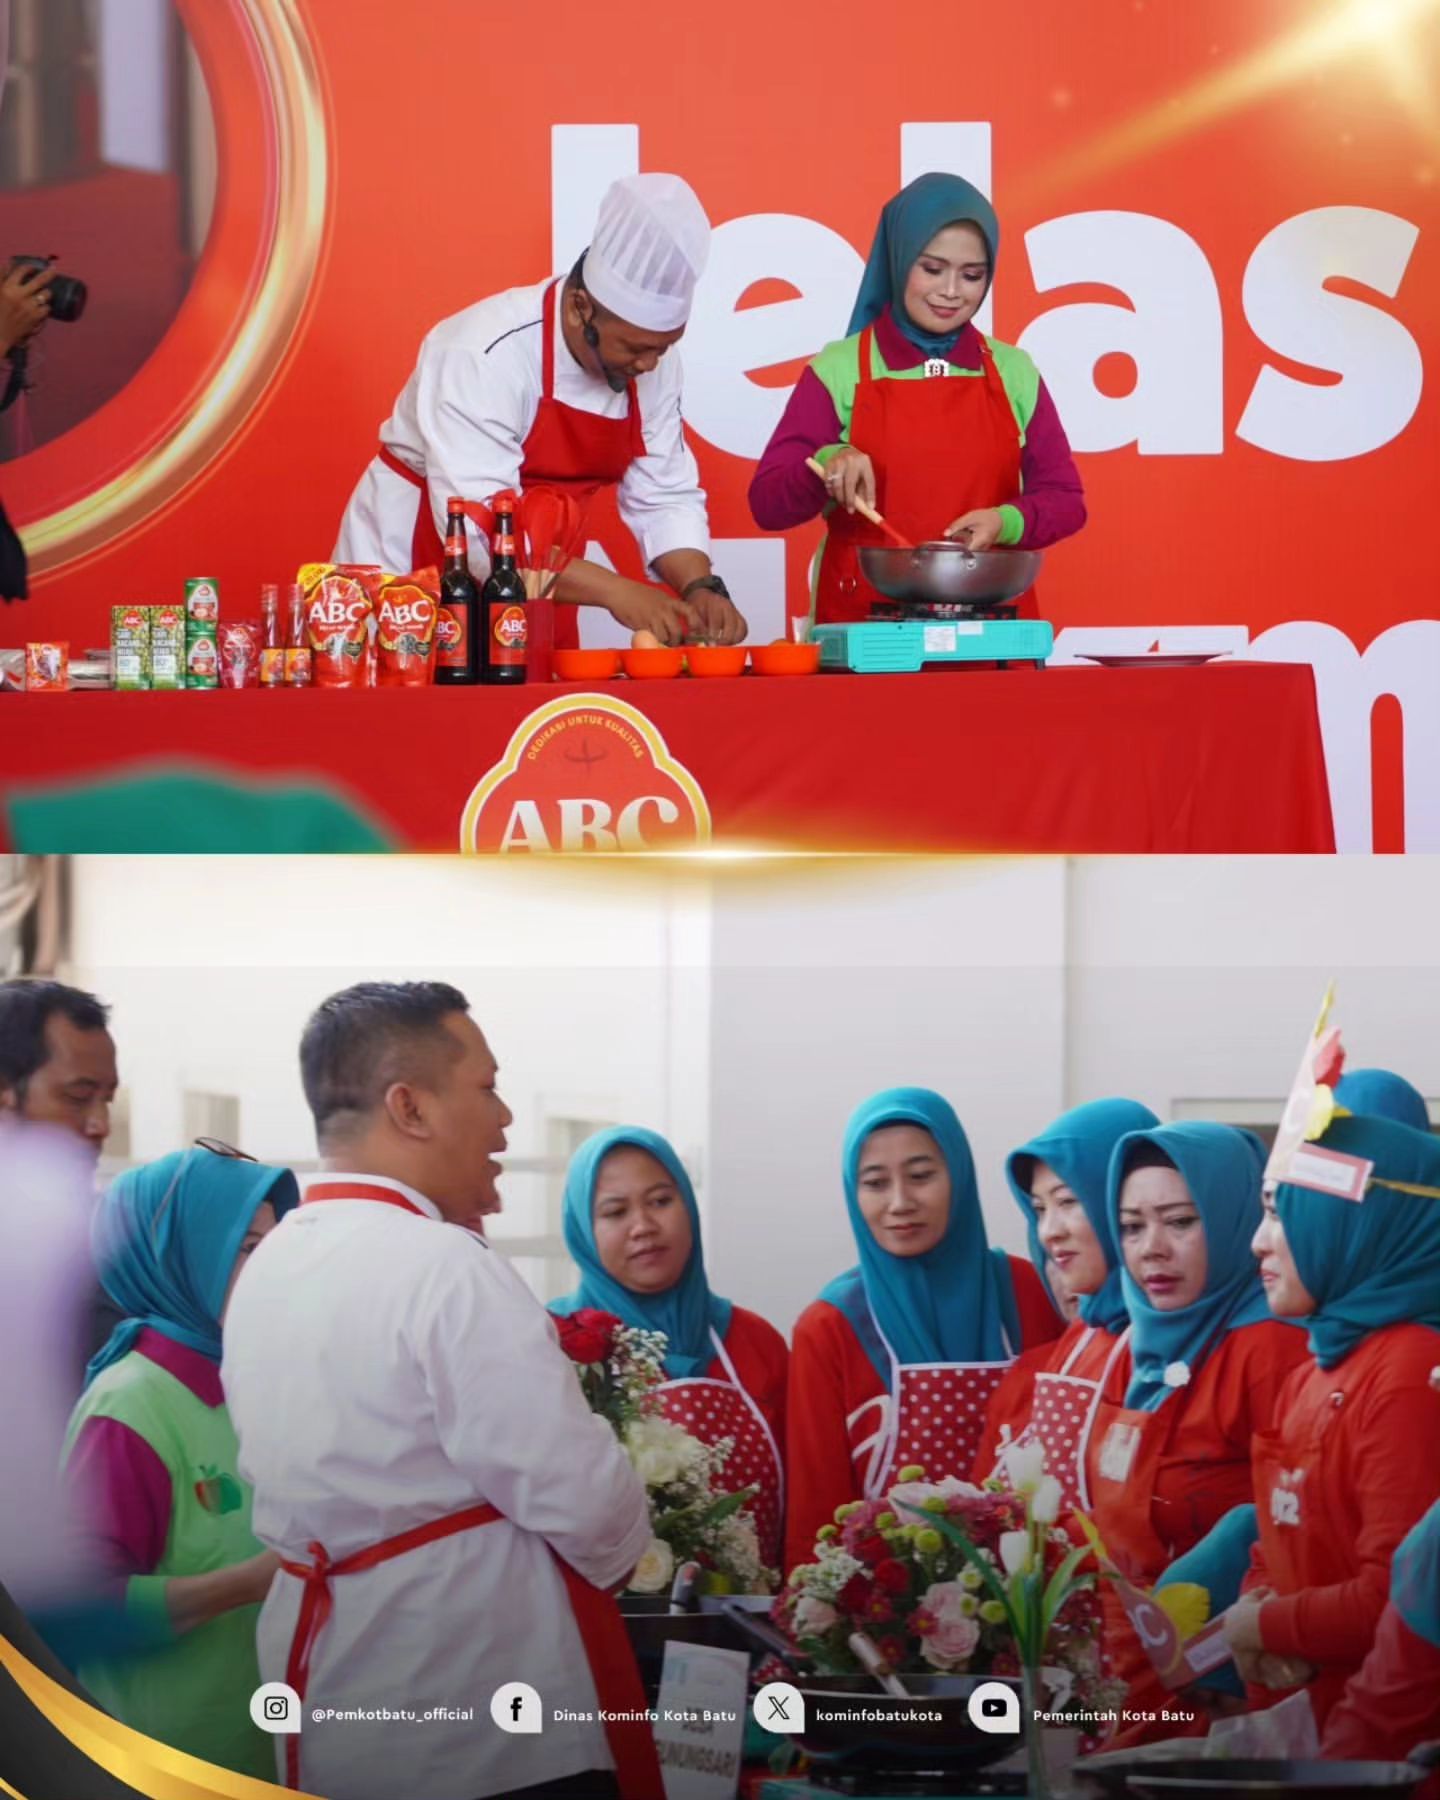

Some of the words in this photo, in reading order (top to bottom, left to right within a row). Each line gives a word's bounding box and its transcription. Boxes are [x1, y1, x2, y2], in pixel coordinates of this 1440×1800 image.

[309, 601, 366, 624] ABC
[379, 599, 431, 625] ABC
[435, 620, 455, 635] BC
[500, 619, 527, 633] ABC
[527, 720, 566, 760] DEDIKASI
[567, 714, 603, 727] UNTUK
[605, 719, 644, 759] KUALITAS
[499, 795, 680, 854] ABC
